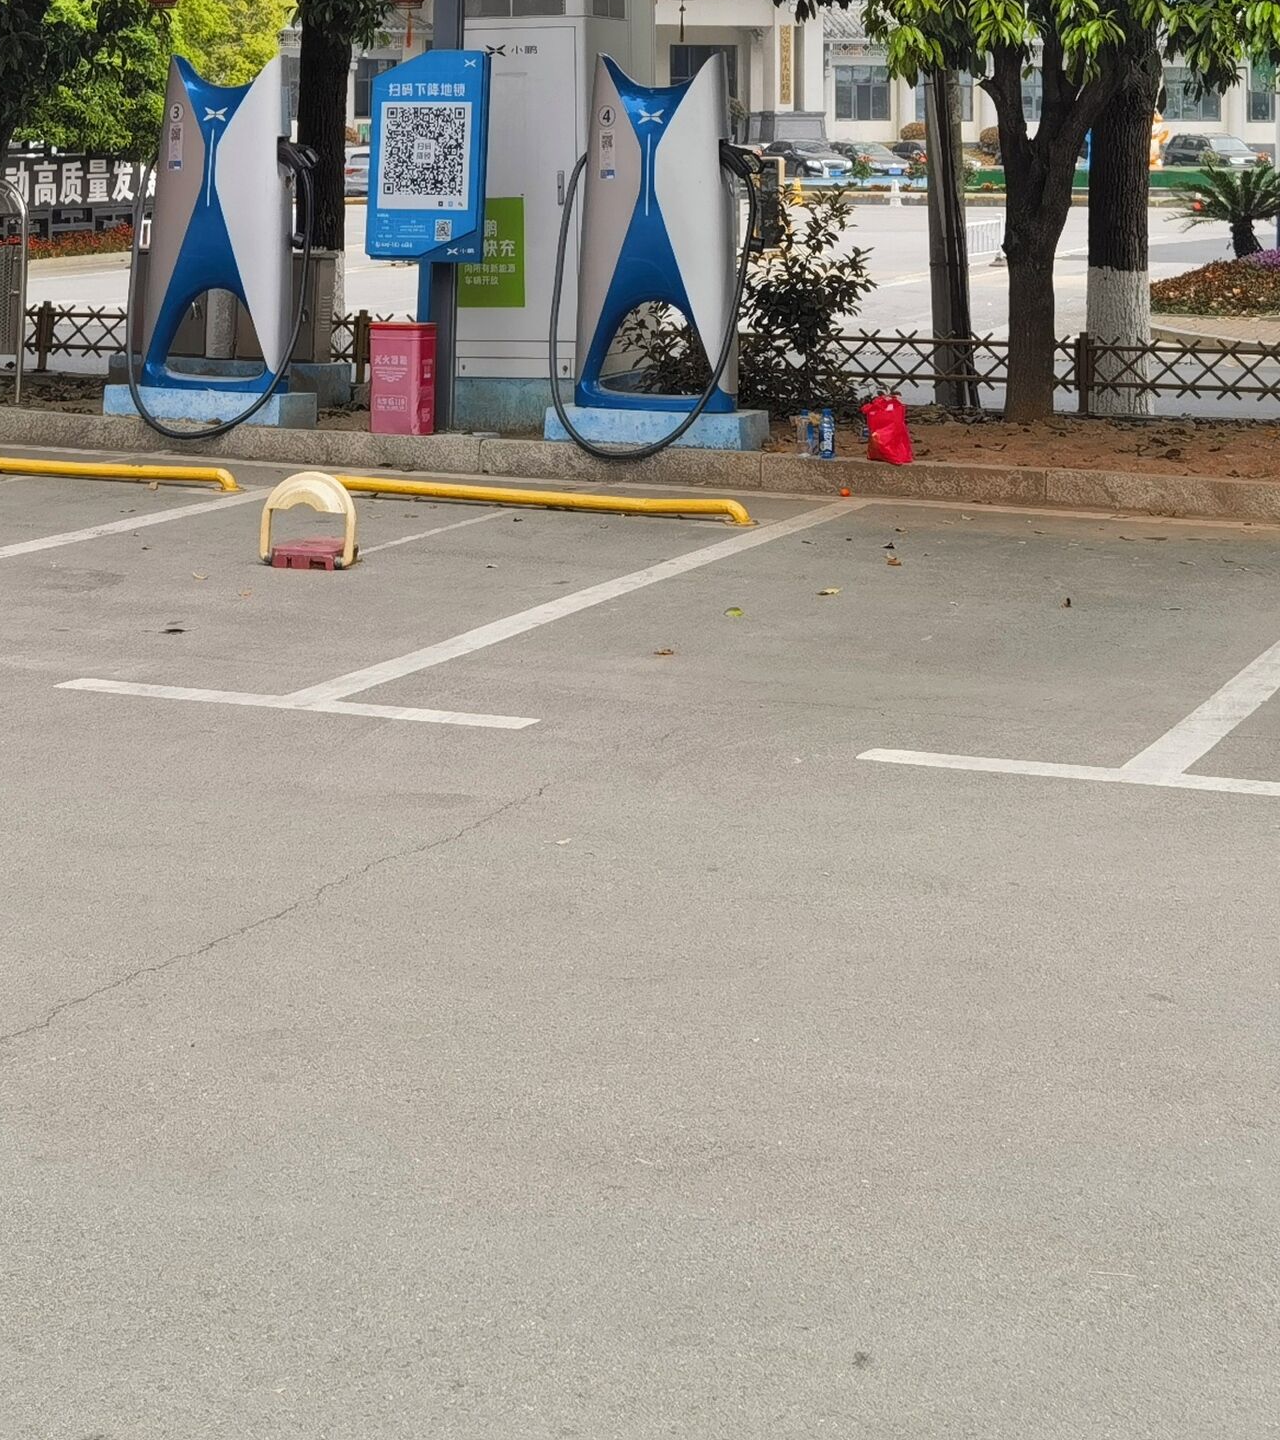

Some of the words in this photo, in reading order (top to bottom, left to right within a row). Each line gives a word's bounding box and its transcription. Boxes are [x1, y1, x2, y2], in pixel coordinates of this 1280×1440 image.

[389, 82, 466, 97] 扫码下降地锁
[173, 106, 180, 119] 3
[602, 109, 611, 123] 4
